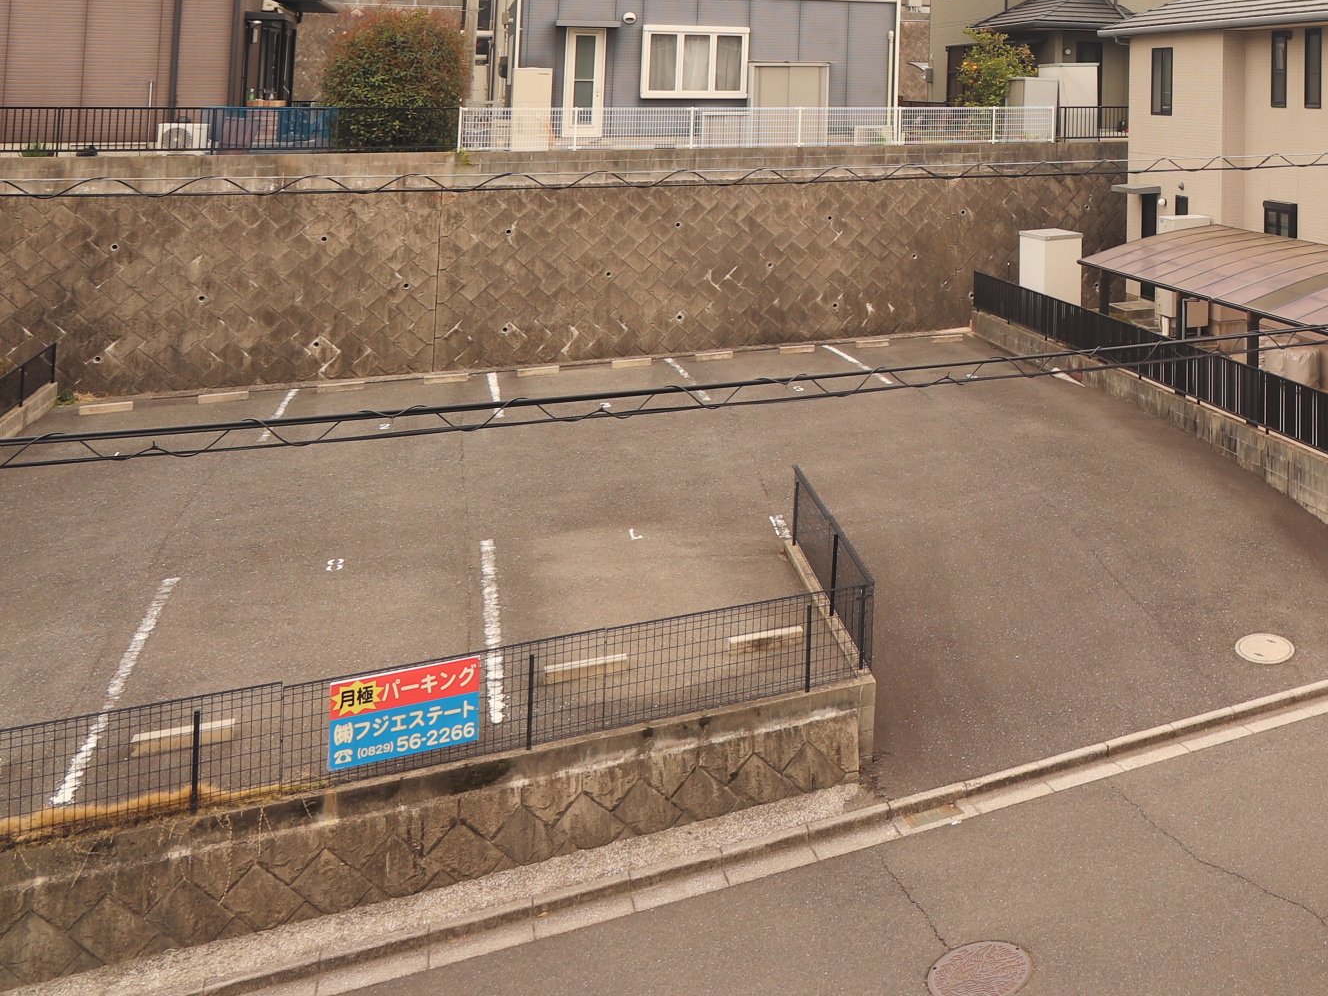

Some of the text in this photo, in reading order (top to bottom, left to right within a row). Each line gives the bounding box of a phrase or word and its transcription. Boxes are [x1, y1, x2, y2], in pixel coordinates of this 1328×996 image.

[340, 664, 477, 709] 月極パーキング
